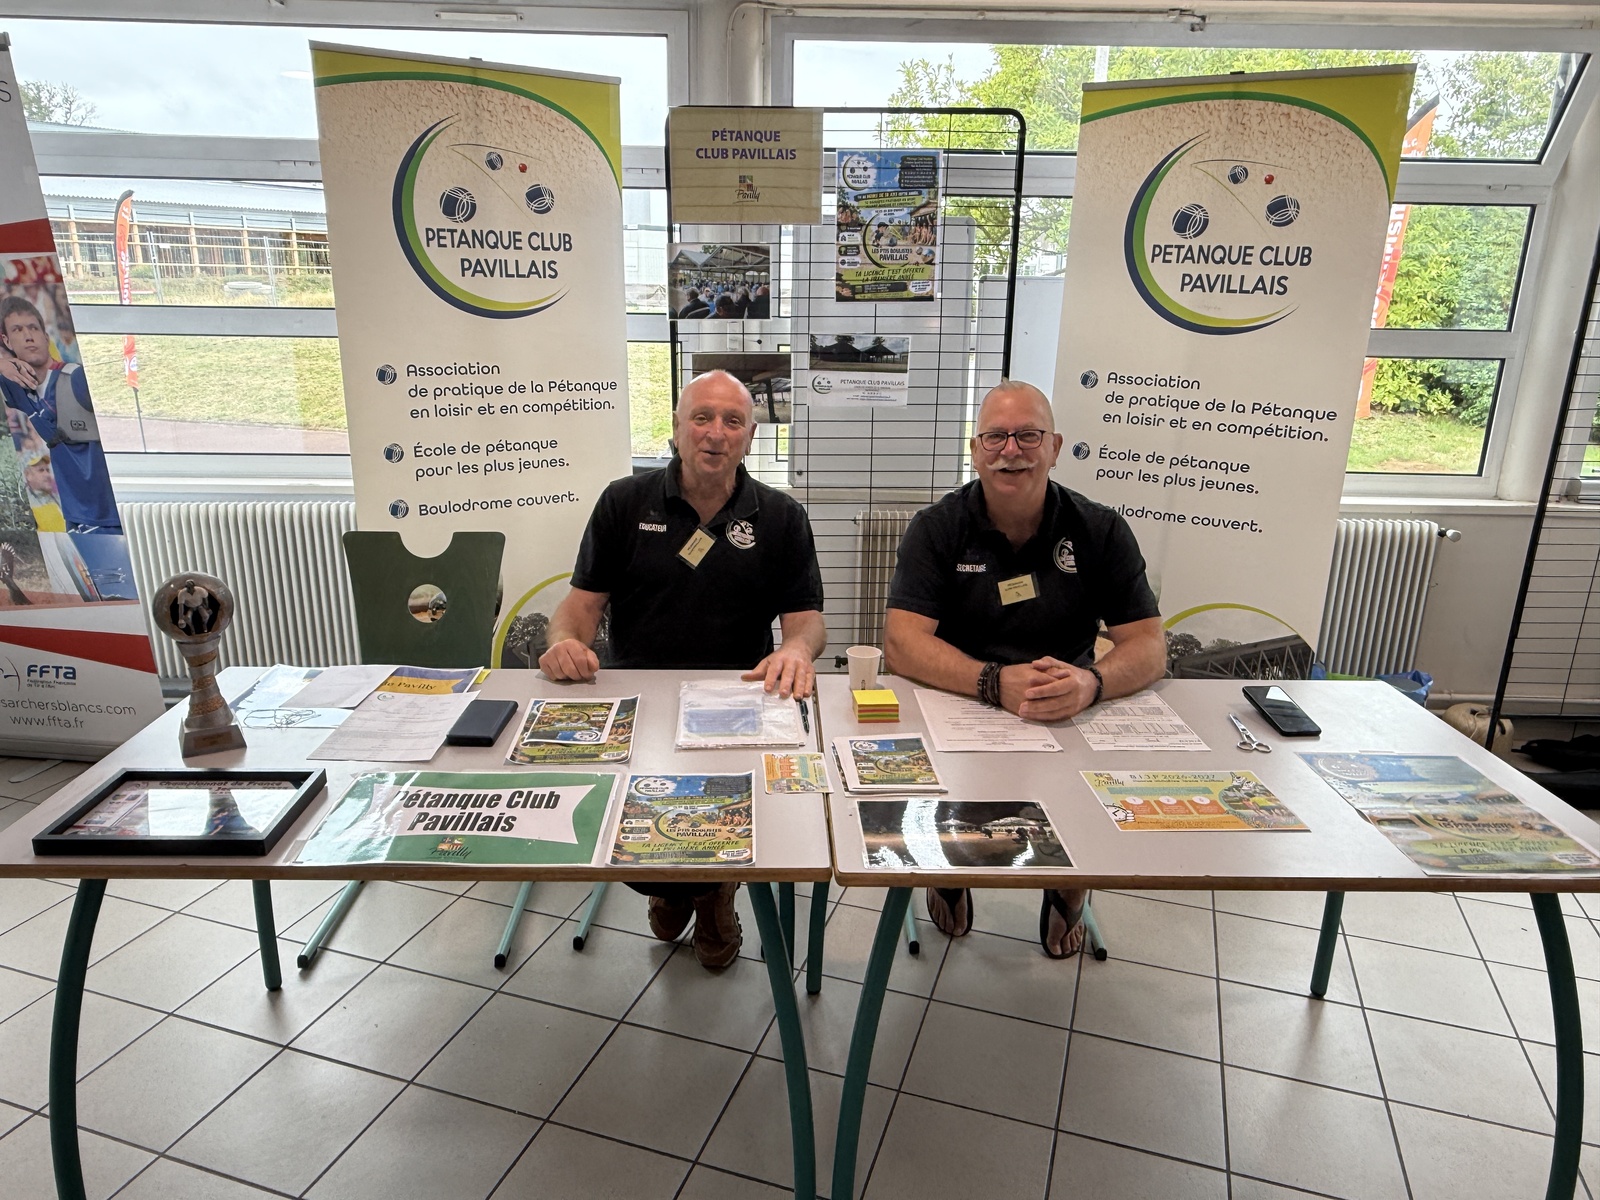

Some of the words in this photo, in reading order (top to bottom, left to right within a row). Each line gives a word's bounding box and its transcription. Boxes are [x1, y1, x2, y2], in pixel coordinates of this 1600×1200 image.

[712, 128, 781, 143] PÉTANQUE
[696, 148, 729, 159] CLUB
[732, 148, 797, 160] PAVILLAIS
[735, 186, 760, 202] Pavilly
[425, 227, 523, 250] PETANQUE
[528, 231, 573, 252] CLUB
[879, 253, 909, 261] PAVILLAIS
[1150, 244, 1254, 265] PETANQUE
[1259, 246, 1313, 267] CLUB
[460, 258, 559, 279] PAVILLAIS
[1180, 273, 1289, 296] PAVILLAIS
[406, 362, 501, 377] Association
[408, 383, 428, 398] de
[433, 381, 504, 400] pratique
[508, 380, 527, 394] de
[531, 380, 544, 393] la
[548, 379, 618, 395] Pétanque
[1107, 372, 1201, 390] Association
[410, 406, 430, 419] en
[434, 403, 473, 418] loisir
[477, 403, 495, 416] et
[499, 403, 518, 414] en
[522, 398, 615, 416] compétition.
[1105, 391, 1124, 405] de
[1128, 395, 1200, 413] pratique
[1205, 399, 1226, 413] de
[1231, 400, 1246, 414] la
[1251, 401, 1338, 423] Pétanque
[1102, 412, 1121, 425] en
[1126, 412, 1165, 428] loisir
[1169, 416, 1187, 429] et
[1192, 419, 1212, 432] en
[1217, 419, 1329, 443] compétition.
[413, 441, 457, 458] École
[461, 440, 481, 454] de
[485, 438, 559, 456] pétanque
[415, 465, 453, 481] pour
[457, 462, 479, 475] les
[483, 459, 515, 476] plus
[517, 456, 570, 474] jeunes.
[1098, 444, 1141, 463] École
[1145, 451, 1166, 465] de
[1169, 453, 1251, 474] pétanque
[1096, 468, 1134, 481] pour
[1138, 469, 1159, 483] les
[1163, 473, 1196, 488] plus
[1199, 478, 1259, 495] jeunes.
[418, 496, 513, 516] Boulodrome
[516, 490, 580, 507] couvert.
[1191, 514, 1264, 534] couvert.
[10, 715, 84, 729] www.ffta.fr
[506, 790, 561, 809] Club
[407, 812, 517, 832] Pavillais
[429, 847, 472, 859] Pavilly
